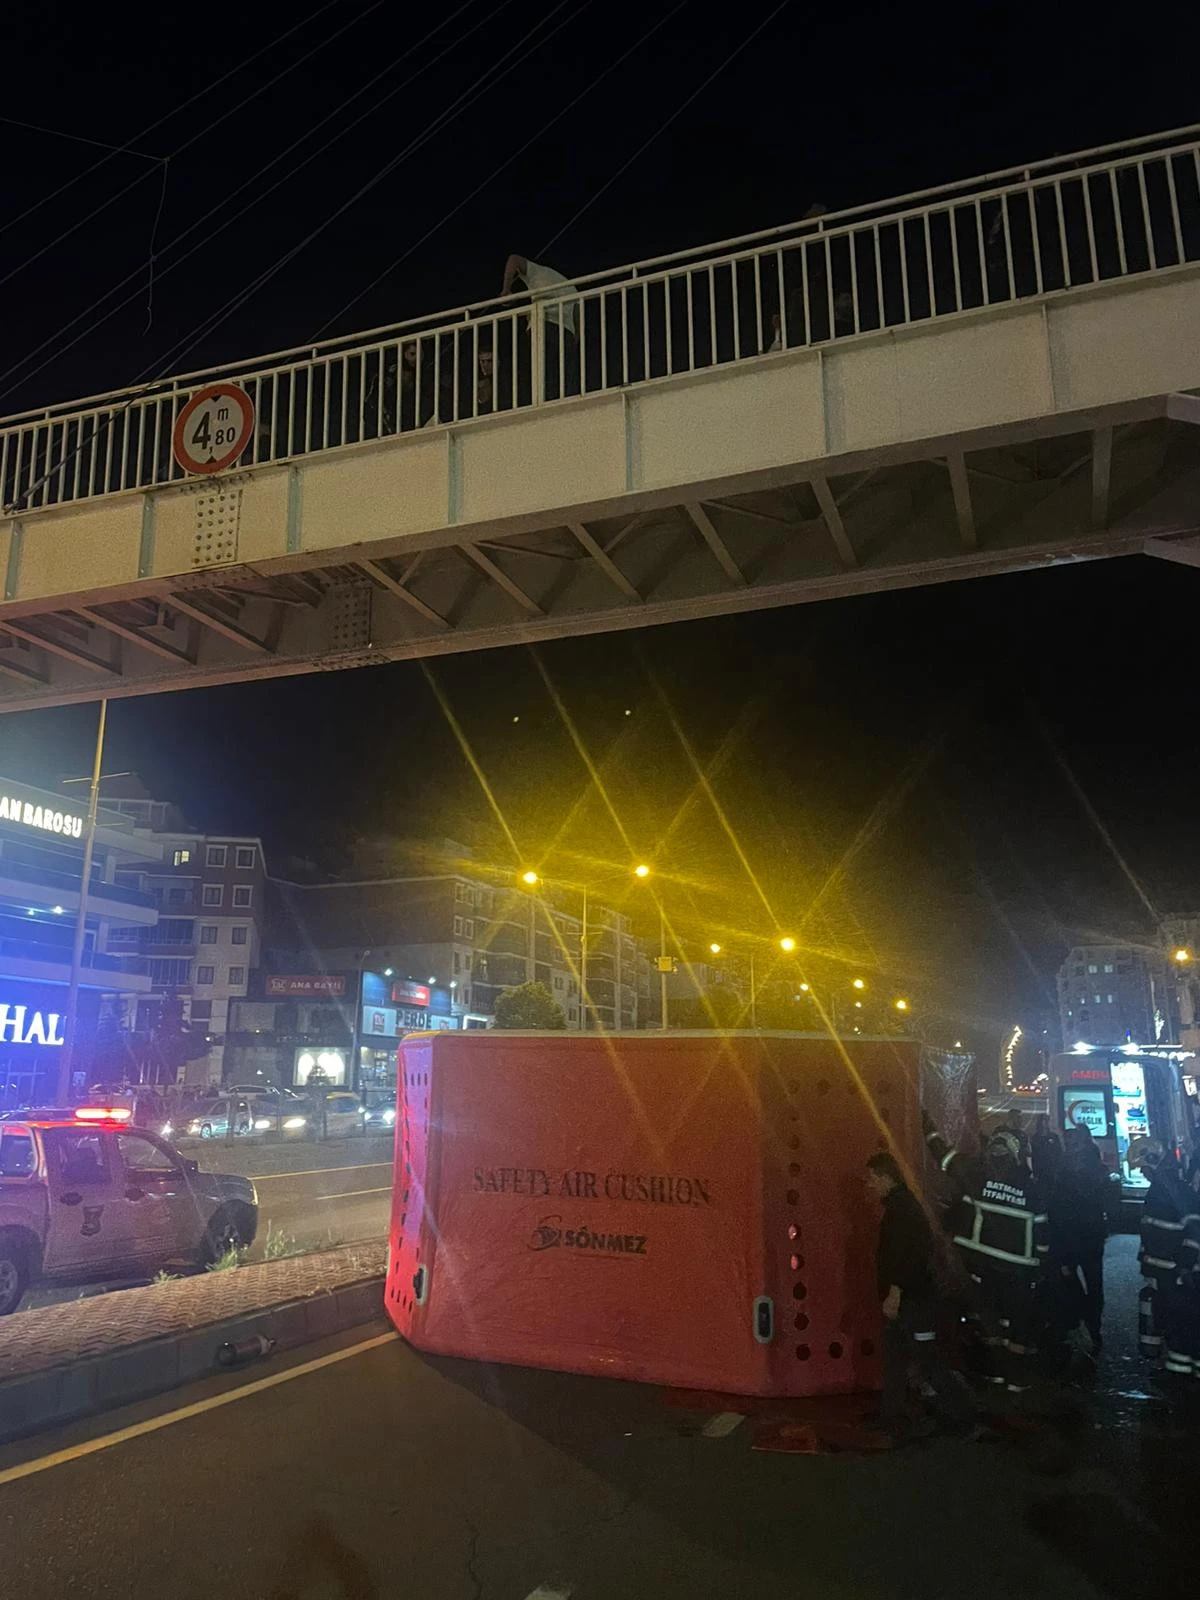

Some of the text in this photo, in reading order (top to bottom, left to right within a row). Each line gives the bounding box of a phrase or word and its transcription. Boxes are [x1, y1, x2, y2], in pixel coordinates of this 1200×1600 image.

[192, 411, 236, 454] 4,80
[23, 803, 83, 838] BAROSU
[0, 1003, 67, 1046] HAL
[473, 1168, 711, 1207] SAFETY AIR CUSHION
[986, 1181, 1024, 1197] BATMAN
[564, 1226, 648, 1254] SÖNMEZ
